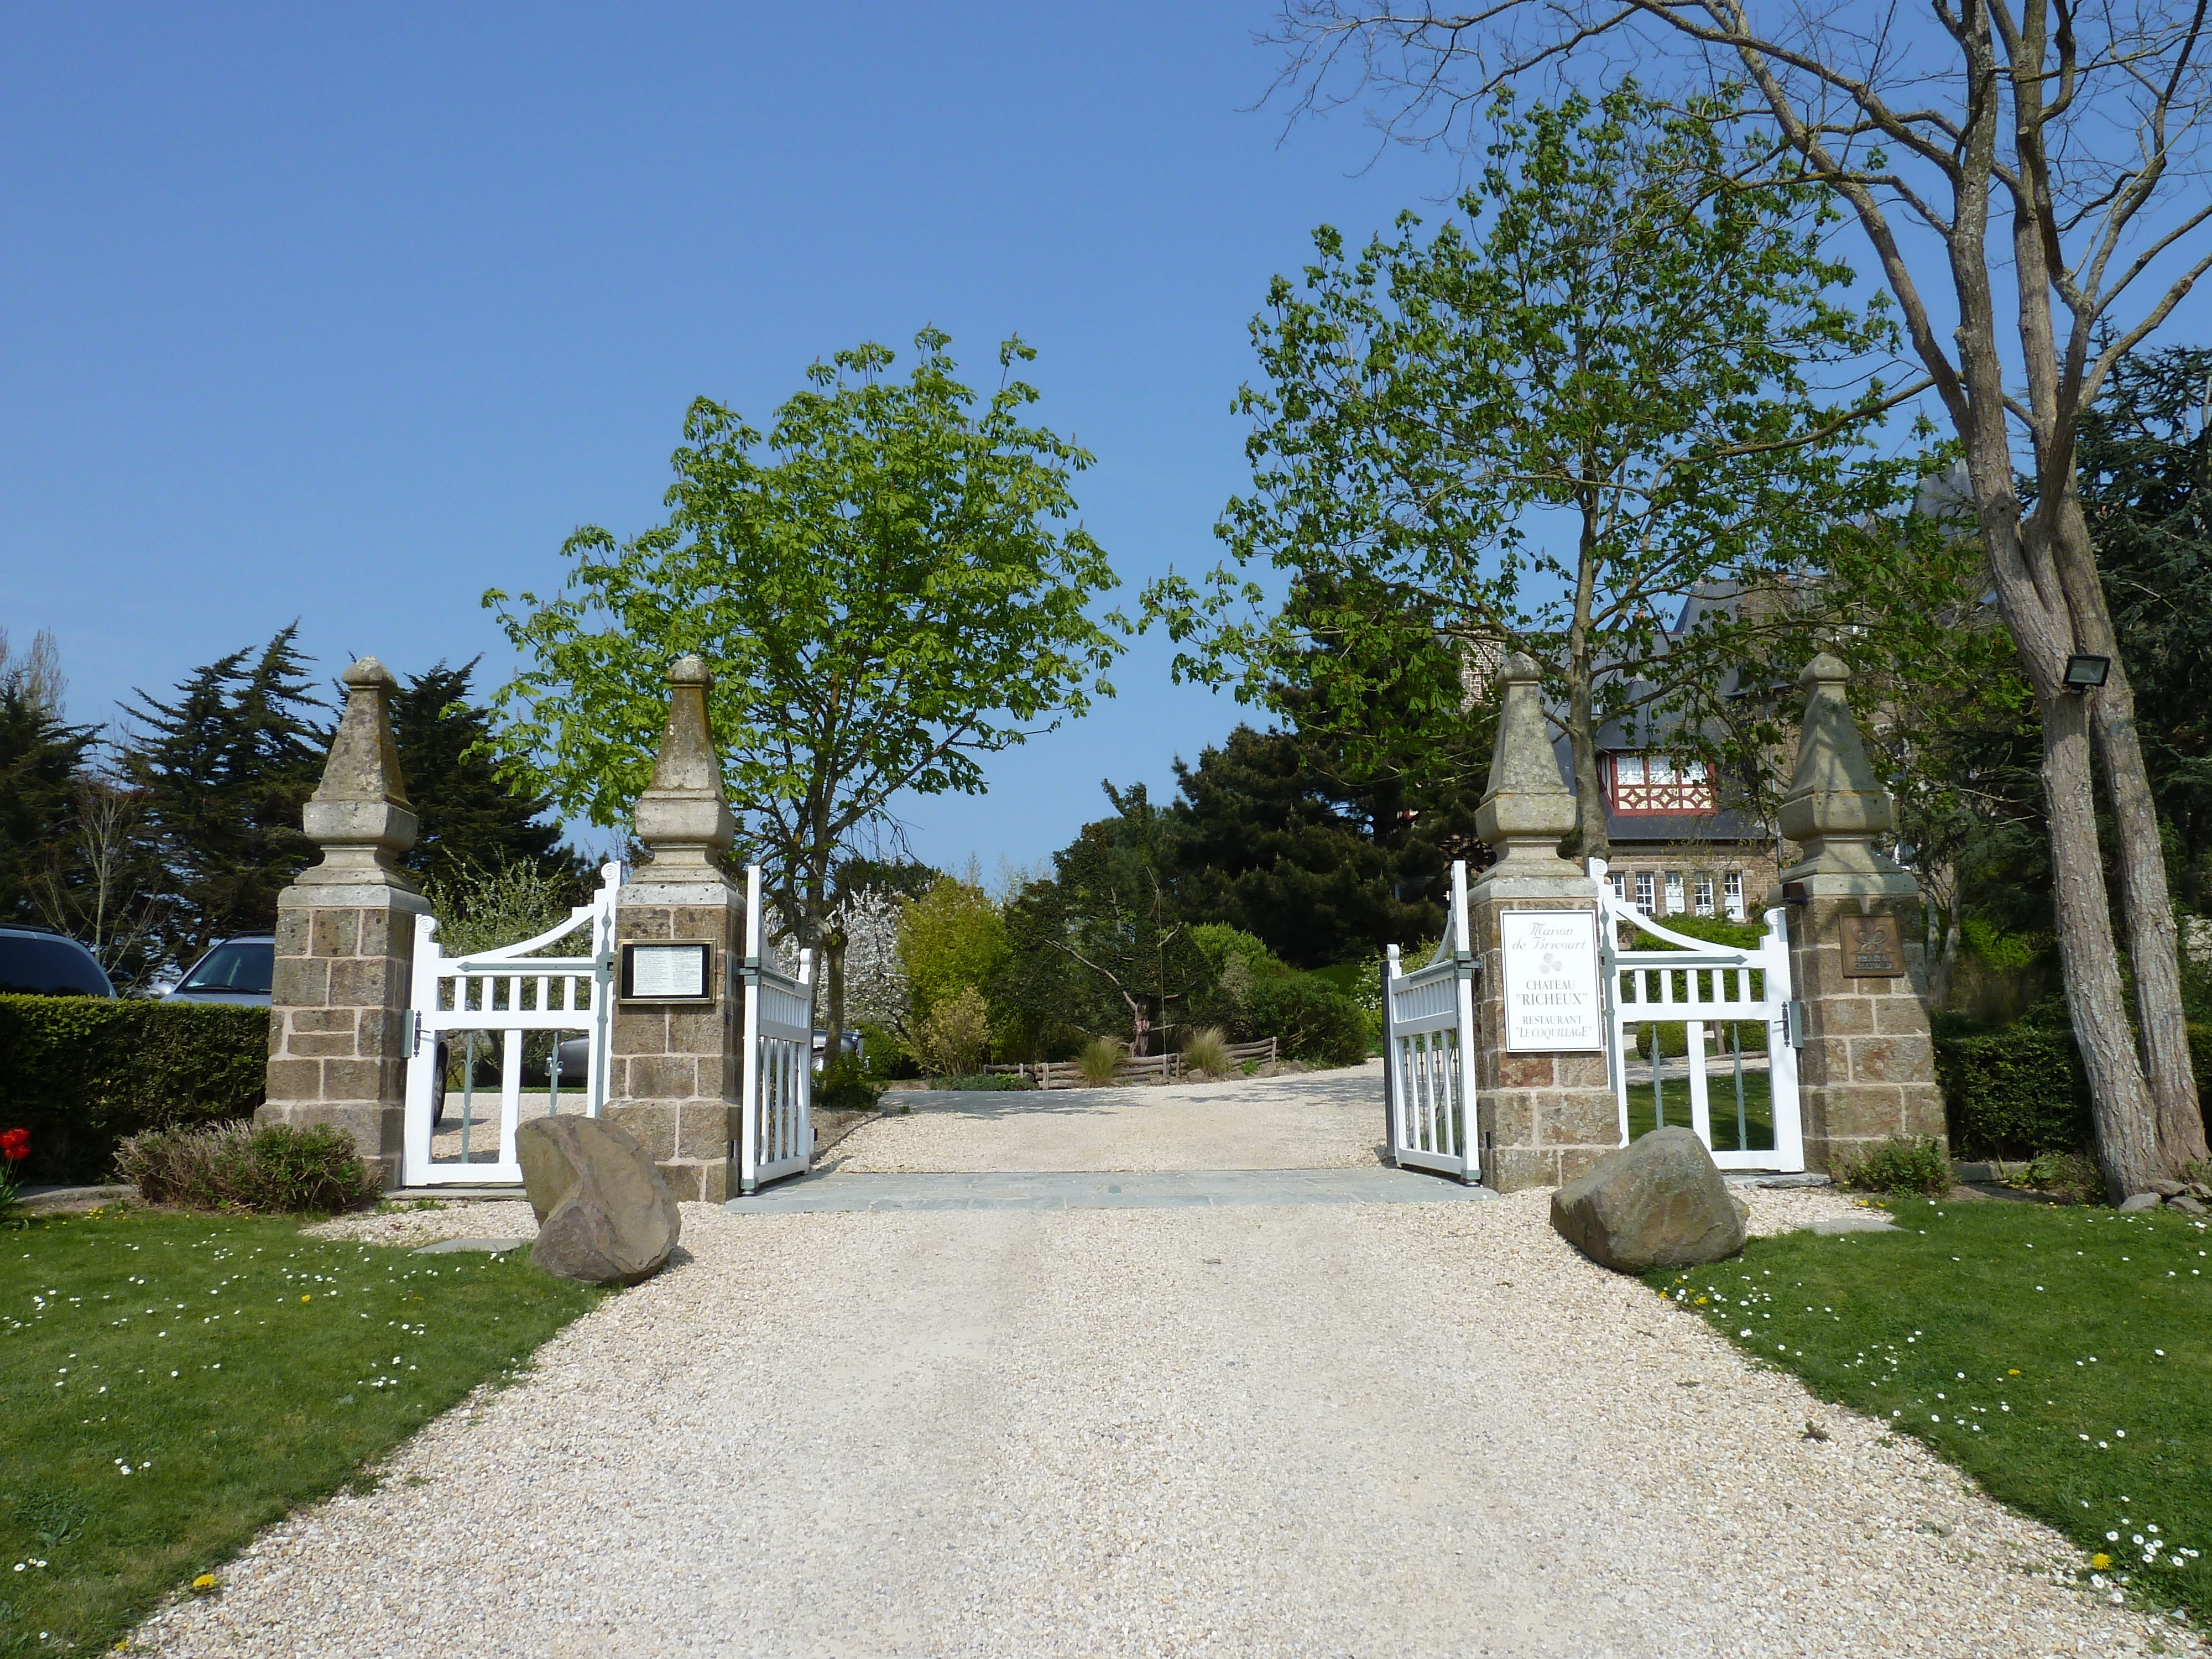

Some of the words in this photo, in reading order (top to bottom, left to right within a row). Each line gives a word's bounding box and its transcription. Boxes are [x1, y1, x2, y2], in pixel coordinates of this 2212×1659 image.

[1527, 922, 1573, 936] Maison
[1512, 937, 1526, 950] de
[1531, 937, 1585, 950] Bricourt
[1526, 980, 1575, 990] CHATEAU
[1523, 1015, 1583, 1025] RESTAURANT
